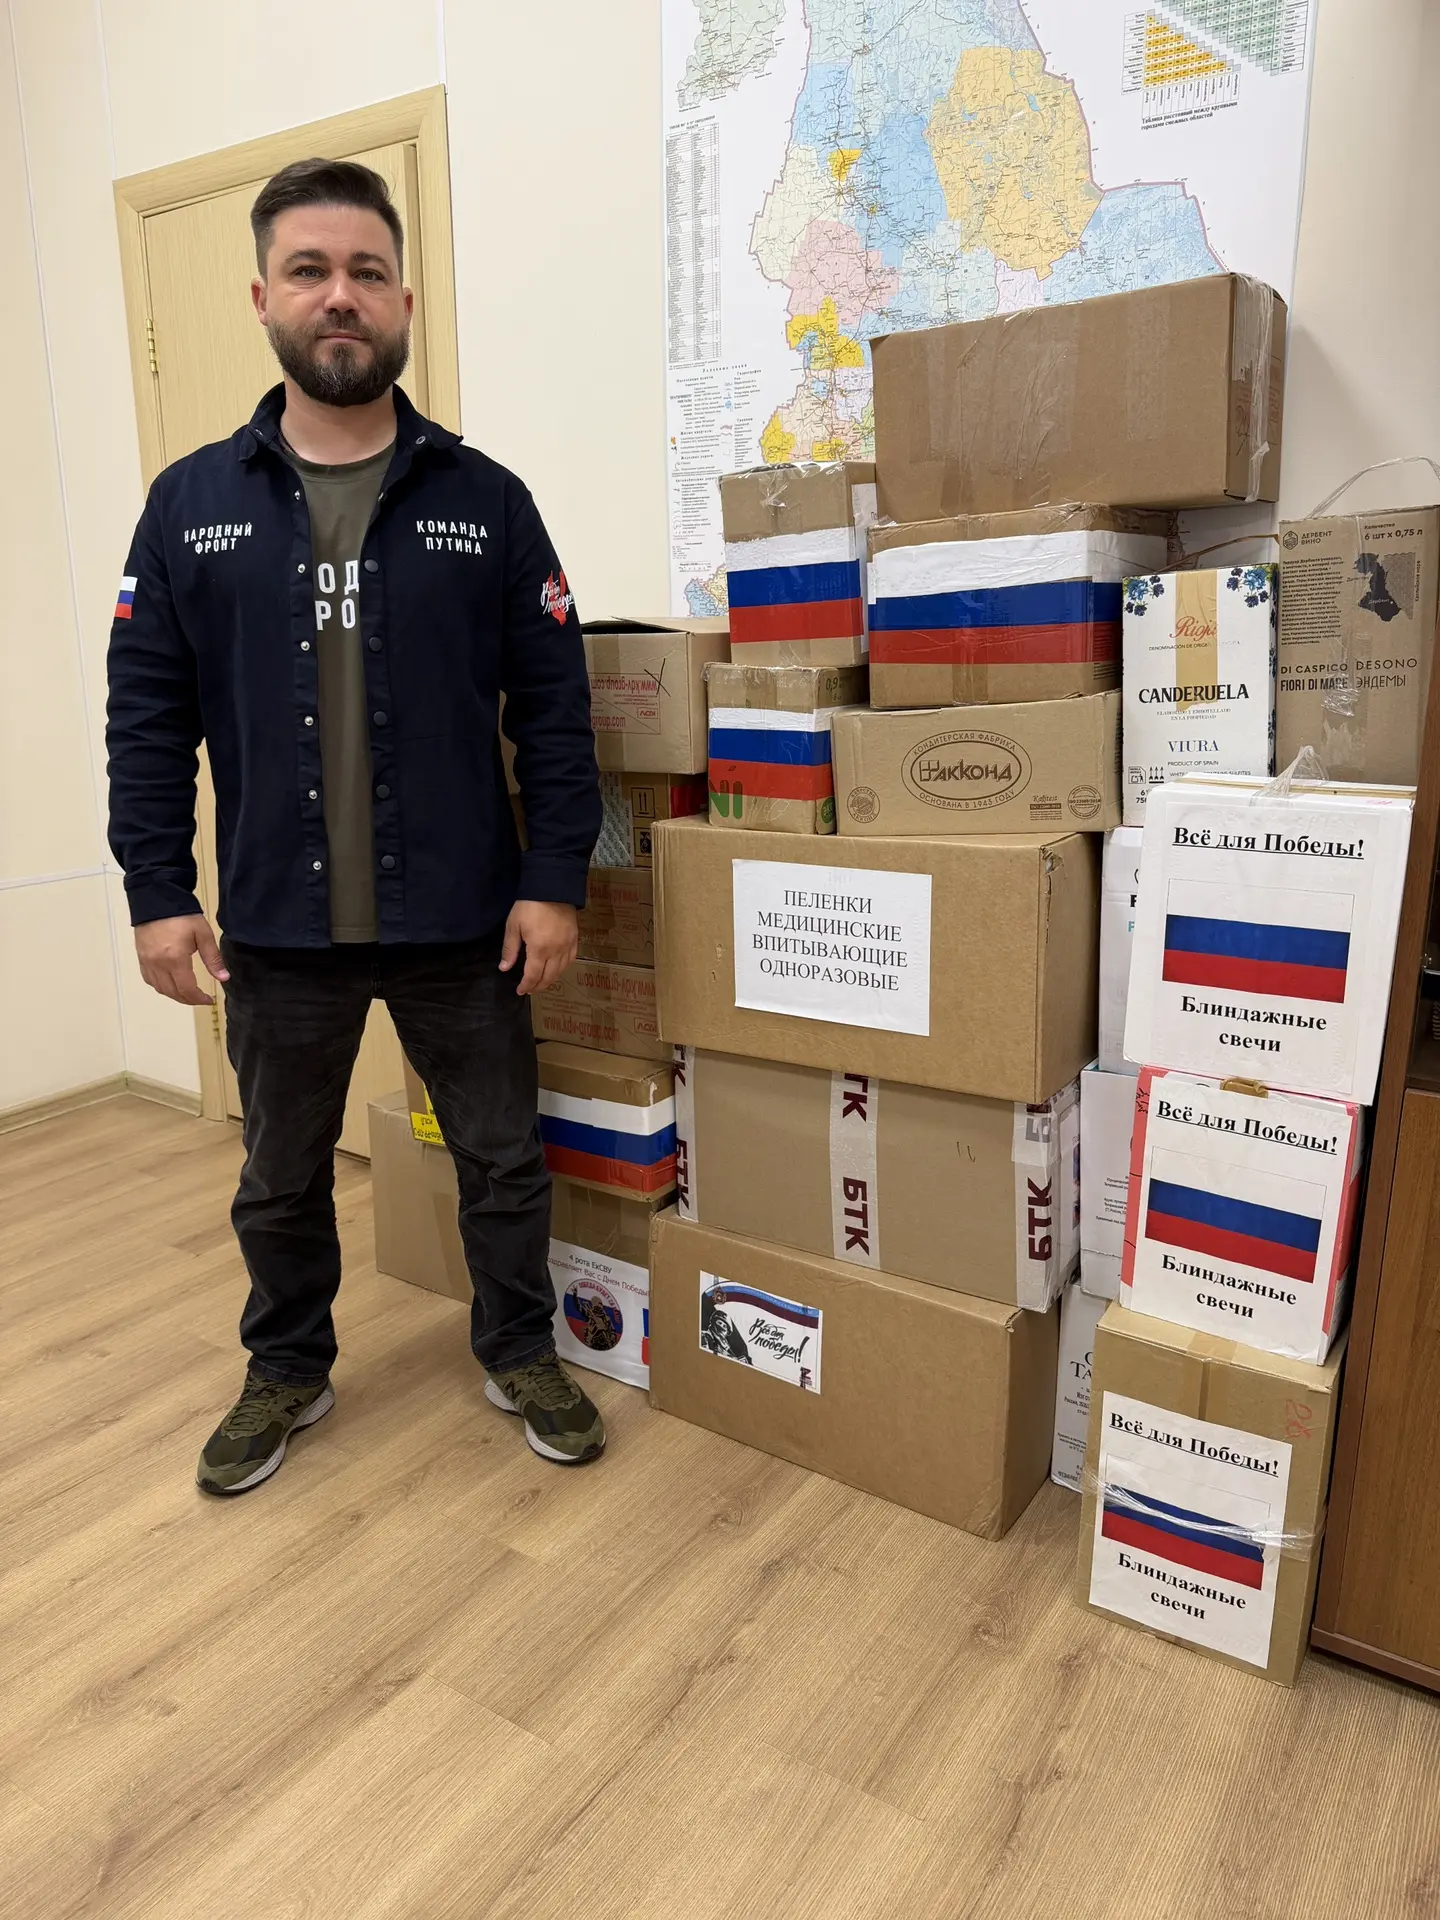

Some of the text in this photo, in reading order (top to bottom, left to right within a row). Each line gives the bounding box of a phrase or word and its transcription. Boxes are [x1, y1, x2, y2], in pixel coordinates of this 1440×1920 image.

[184, 522, 252, 543] НАРОДНЫЙ
[416, 520, 488, 538] КОМАНДА
[1301, 530, 1333, 539] ДЕРБЕНТ
[1365, 533, 1370, 541] 6
[1372, 532, 1385, 540] шт
[1395, 528, 1415, 539] 0,75
[195, 537, 237, 554] ФРОНТ
[426, 537, 482, 555] ПУТИНА
[1301, 538, 1322, 546] ВИНО
[1281, 658, 1417, 674] DI CASPICO DESONO
[1281, 676, 1348, 692] FIORI DI MARE
[1356, 675, 1406, 690] ЭНДЕМЫ
[1138, 683, 1250, 704] CANDERUELA
[913, 732, 1017, 756] КОНДИТЕРСКАЯ ФАБРИКА
[1168, 740, 1220, 753] VIURA
[919, 792, 963, 809] ОСНОВАНА
[994, 789, 1016, 803] ГОДУ
[1173, 827, 1364, 858] Всё для Победы!
[784, 890, 873, 914] ПЕЛЕНКИ
[757, 911, 903, 942] МЕДИЦИНСКИЕ
[752, 933, 908, 968] ВПИТЫВАЮЩИЕ
[760, 957, 900, 992] ОДНОРАЗОВЫЕ
[1181, 995, 1327, 1031] Блиндажные
[1219, 1032, 1282, 1053] свечи
[1157, 1100, 1338, 1153] Всё для Победы!
[842, 1176, 870, 1257] БТК
[1027, 1176, 1053, 1261] БТК
[575, 1257, 590, 1267] рота
[584, 1269, 596, 1279] Вас
[603, 1275, 621, 1288] Днем
[1161, 1253, 1297, 1306] Блиндажные
[1196, 1293, 1255, 1319] свечи
[1109, 1412, 1280, 1475] Всё для Победы!
[1117, 1552, 1247, 1610] Блиндажные
[1150, 1591, 1206, 1620] свечи
